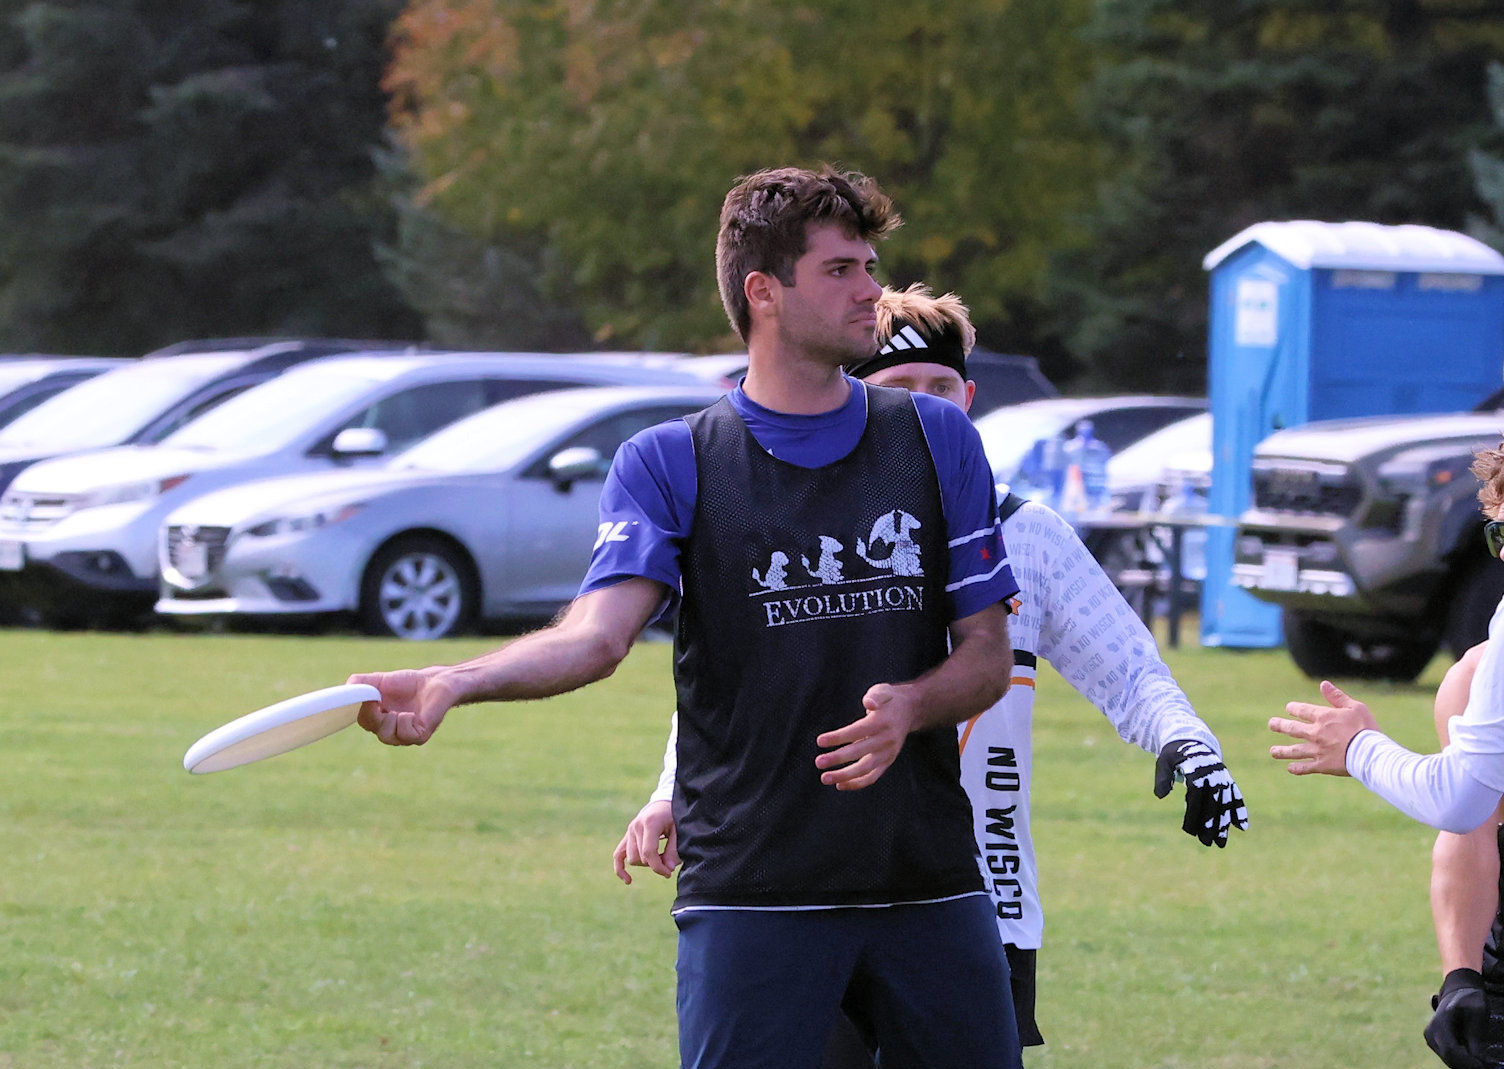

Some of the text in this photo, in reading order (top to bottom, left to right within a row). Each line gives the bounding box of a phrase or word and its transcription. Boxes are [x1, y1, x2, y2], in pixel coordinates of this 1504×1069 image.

[762, 585, 924, 628] EVOLUTION
[1077, 634, 1092, 650] NO
[1088, 612, 1117, 640] WISCO
[1105, 670, 1119, 685] NO
[985, 746, 1024, 920] NO WISCO
